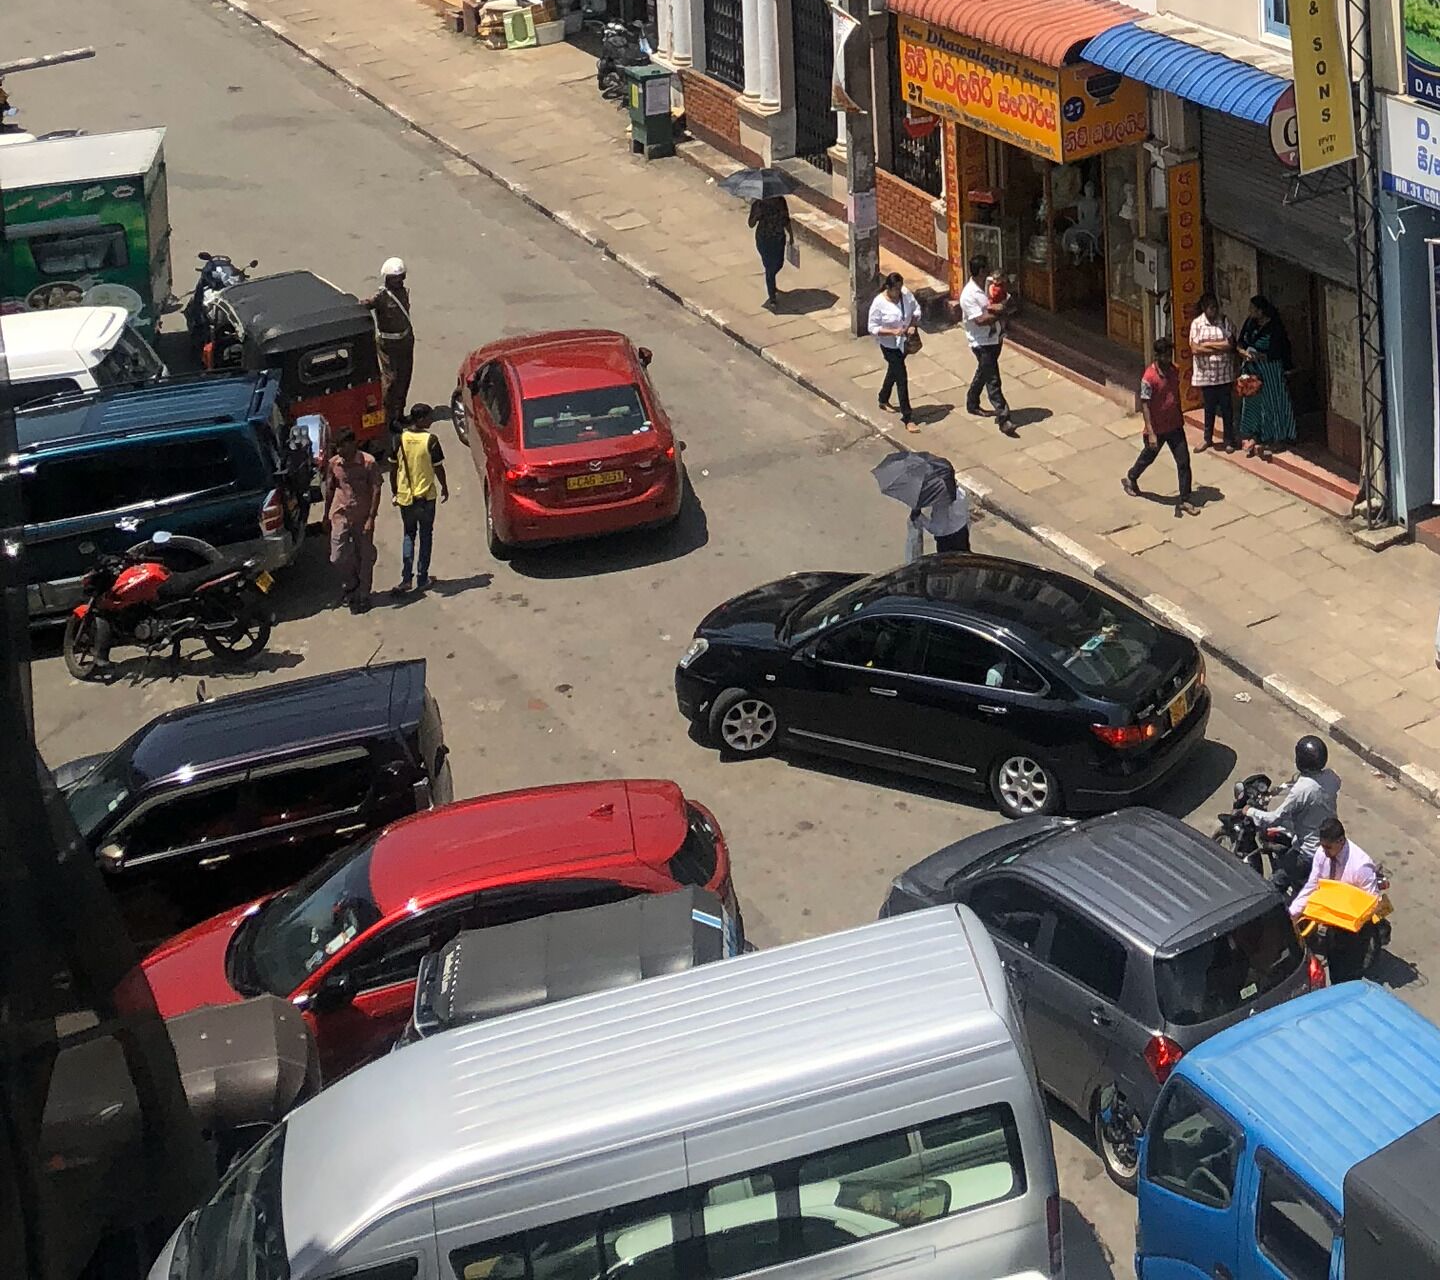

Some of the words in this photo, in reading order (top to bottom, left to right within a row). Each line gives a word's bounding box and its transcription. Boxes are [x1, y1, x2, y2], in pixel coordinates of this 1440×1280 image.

[1308, 0, 1319, 15] &
[927, 28, 1019, 74] Dhawalagiri
[1312, 36, 1332, 123] SONS
[1416, 79, 1423, 92] D
[1425, 81, 1434, 96] A
[908, 81, 923, 104] 27
[1065, 101, 1081, 117] 27
[1416, 117, 1437, 144] D.
